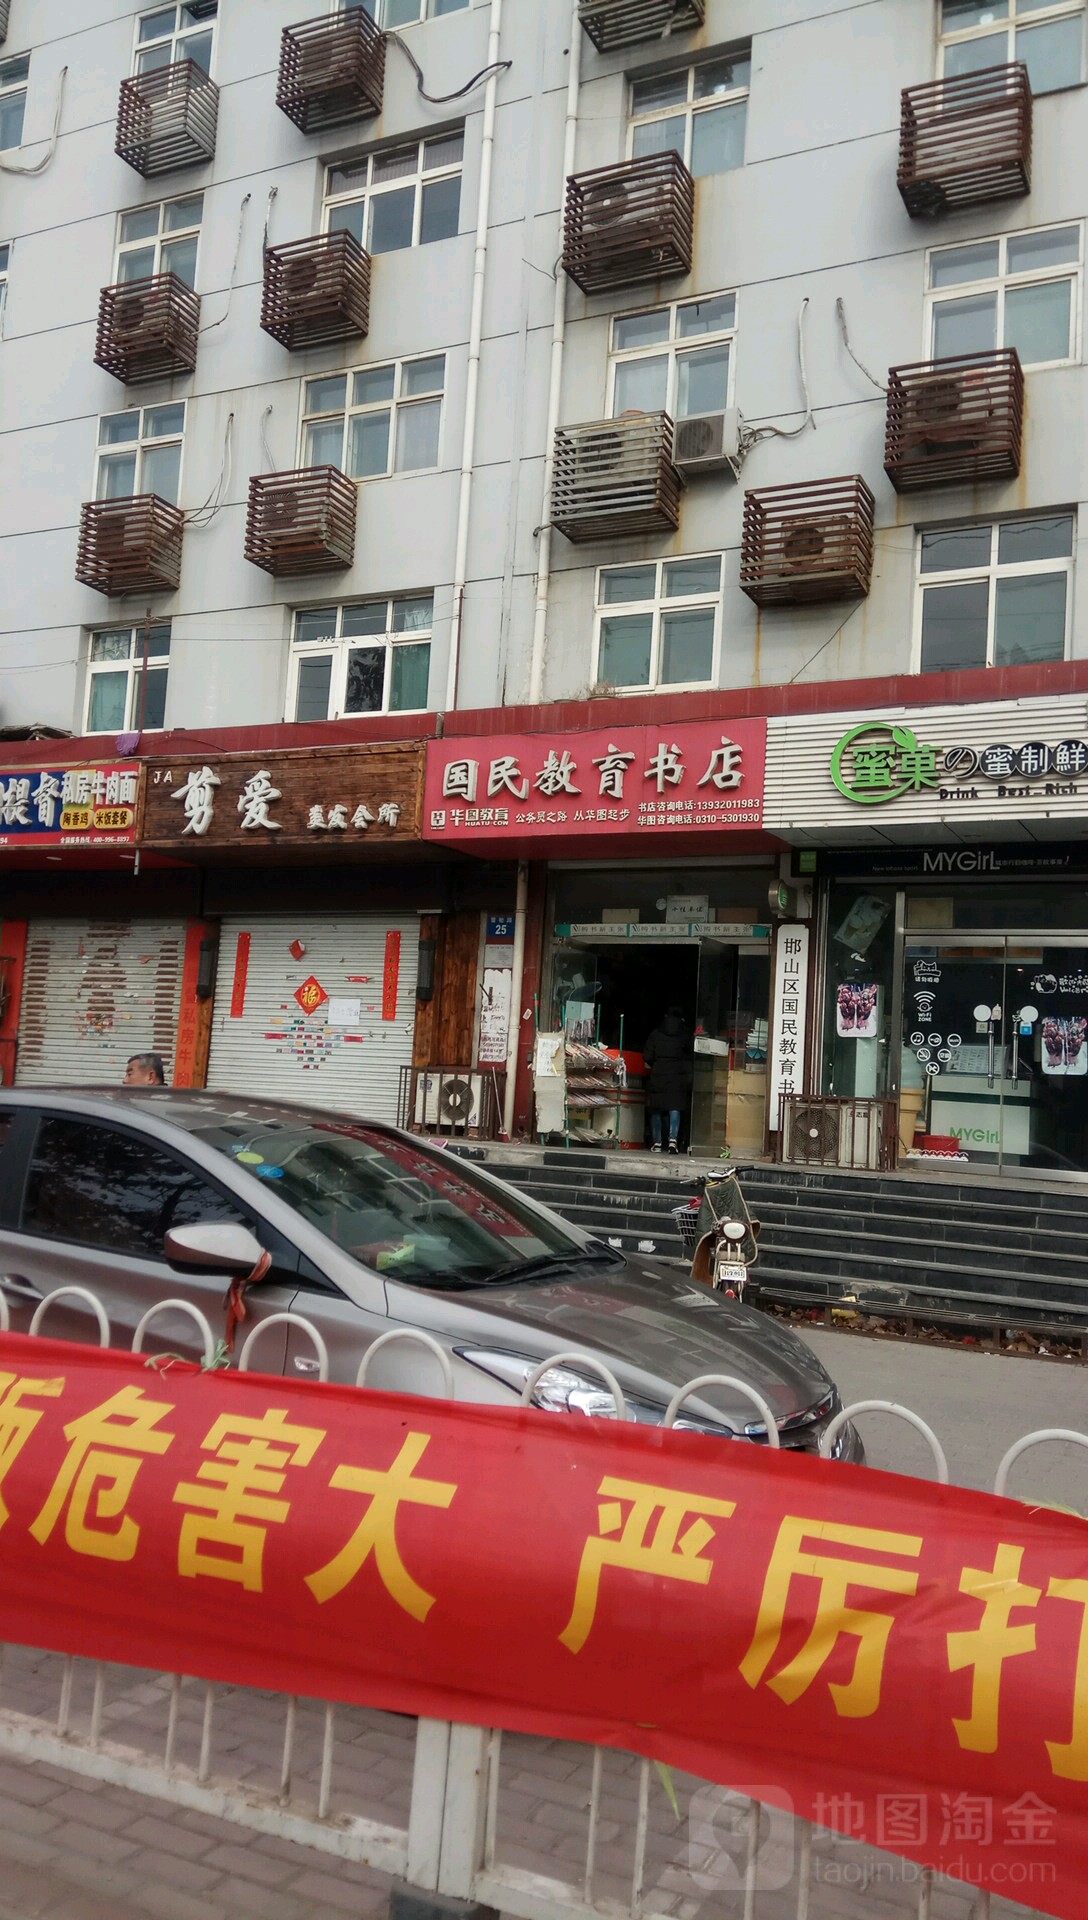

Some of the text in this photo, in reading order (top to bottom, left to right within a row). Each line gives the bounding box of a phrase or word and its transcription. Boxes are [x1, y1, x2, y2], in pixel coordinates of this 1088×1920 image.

[153, 770, 173, 784] JA
[443, 735, 745, 802] 国民教育书店
[61, 770, 138, 805] 私房牛肉面
[939, 782, 1077, 799] Drink Best Rich
[170, 766, 283, 836] 剪爱
[638, 799, 760, 813] 书店咨询电话:13932011983
[62, 811, 128, 826] 陶香鸡 米饭套餐
[450, 807, 509, 826] 华图教育
[515, 808, 631, 824] 公务员之路 从华图起步
[637, 813, 760, 826] 华图咨询电话:0310-5301930
[495, 924, 507, 935] 25
[301, 984, 320, 1004] 福
[778, 938, 802, 1098] 邯山区国民教育书
[557, 1475, 1088, 1783] 严厉打
